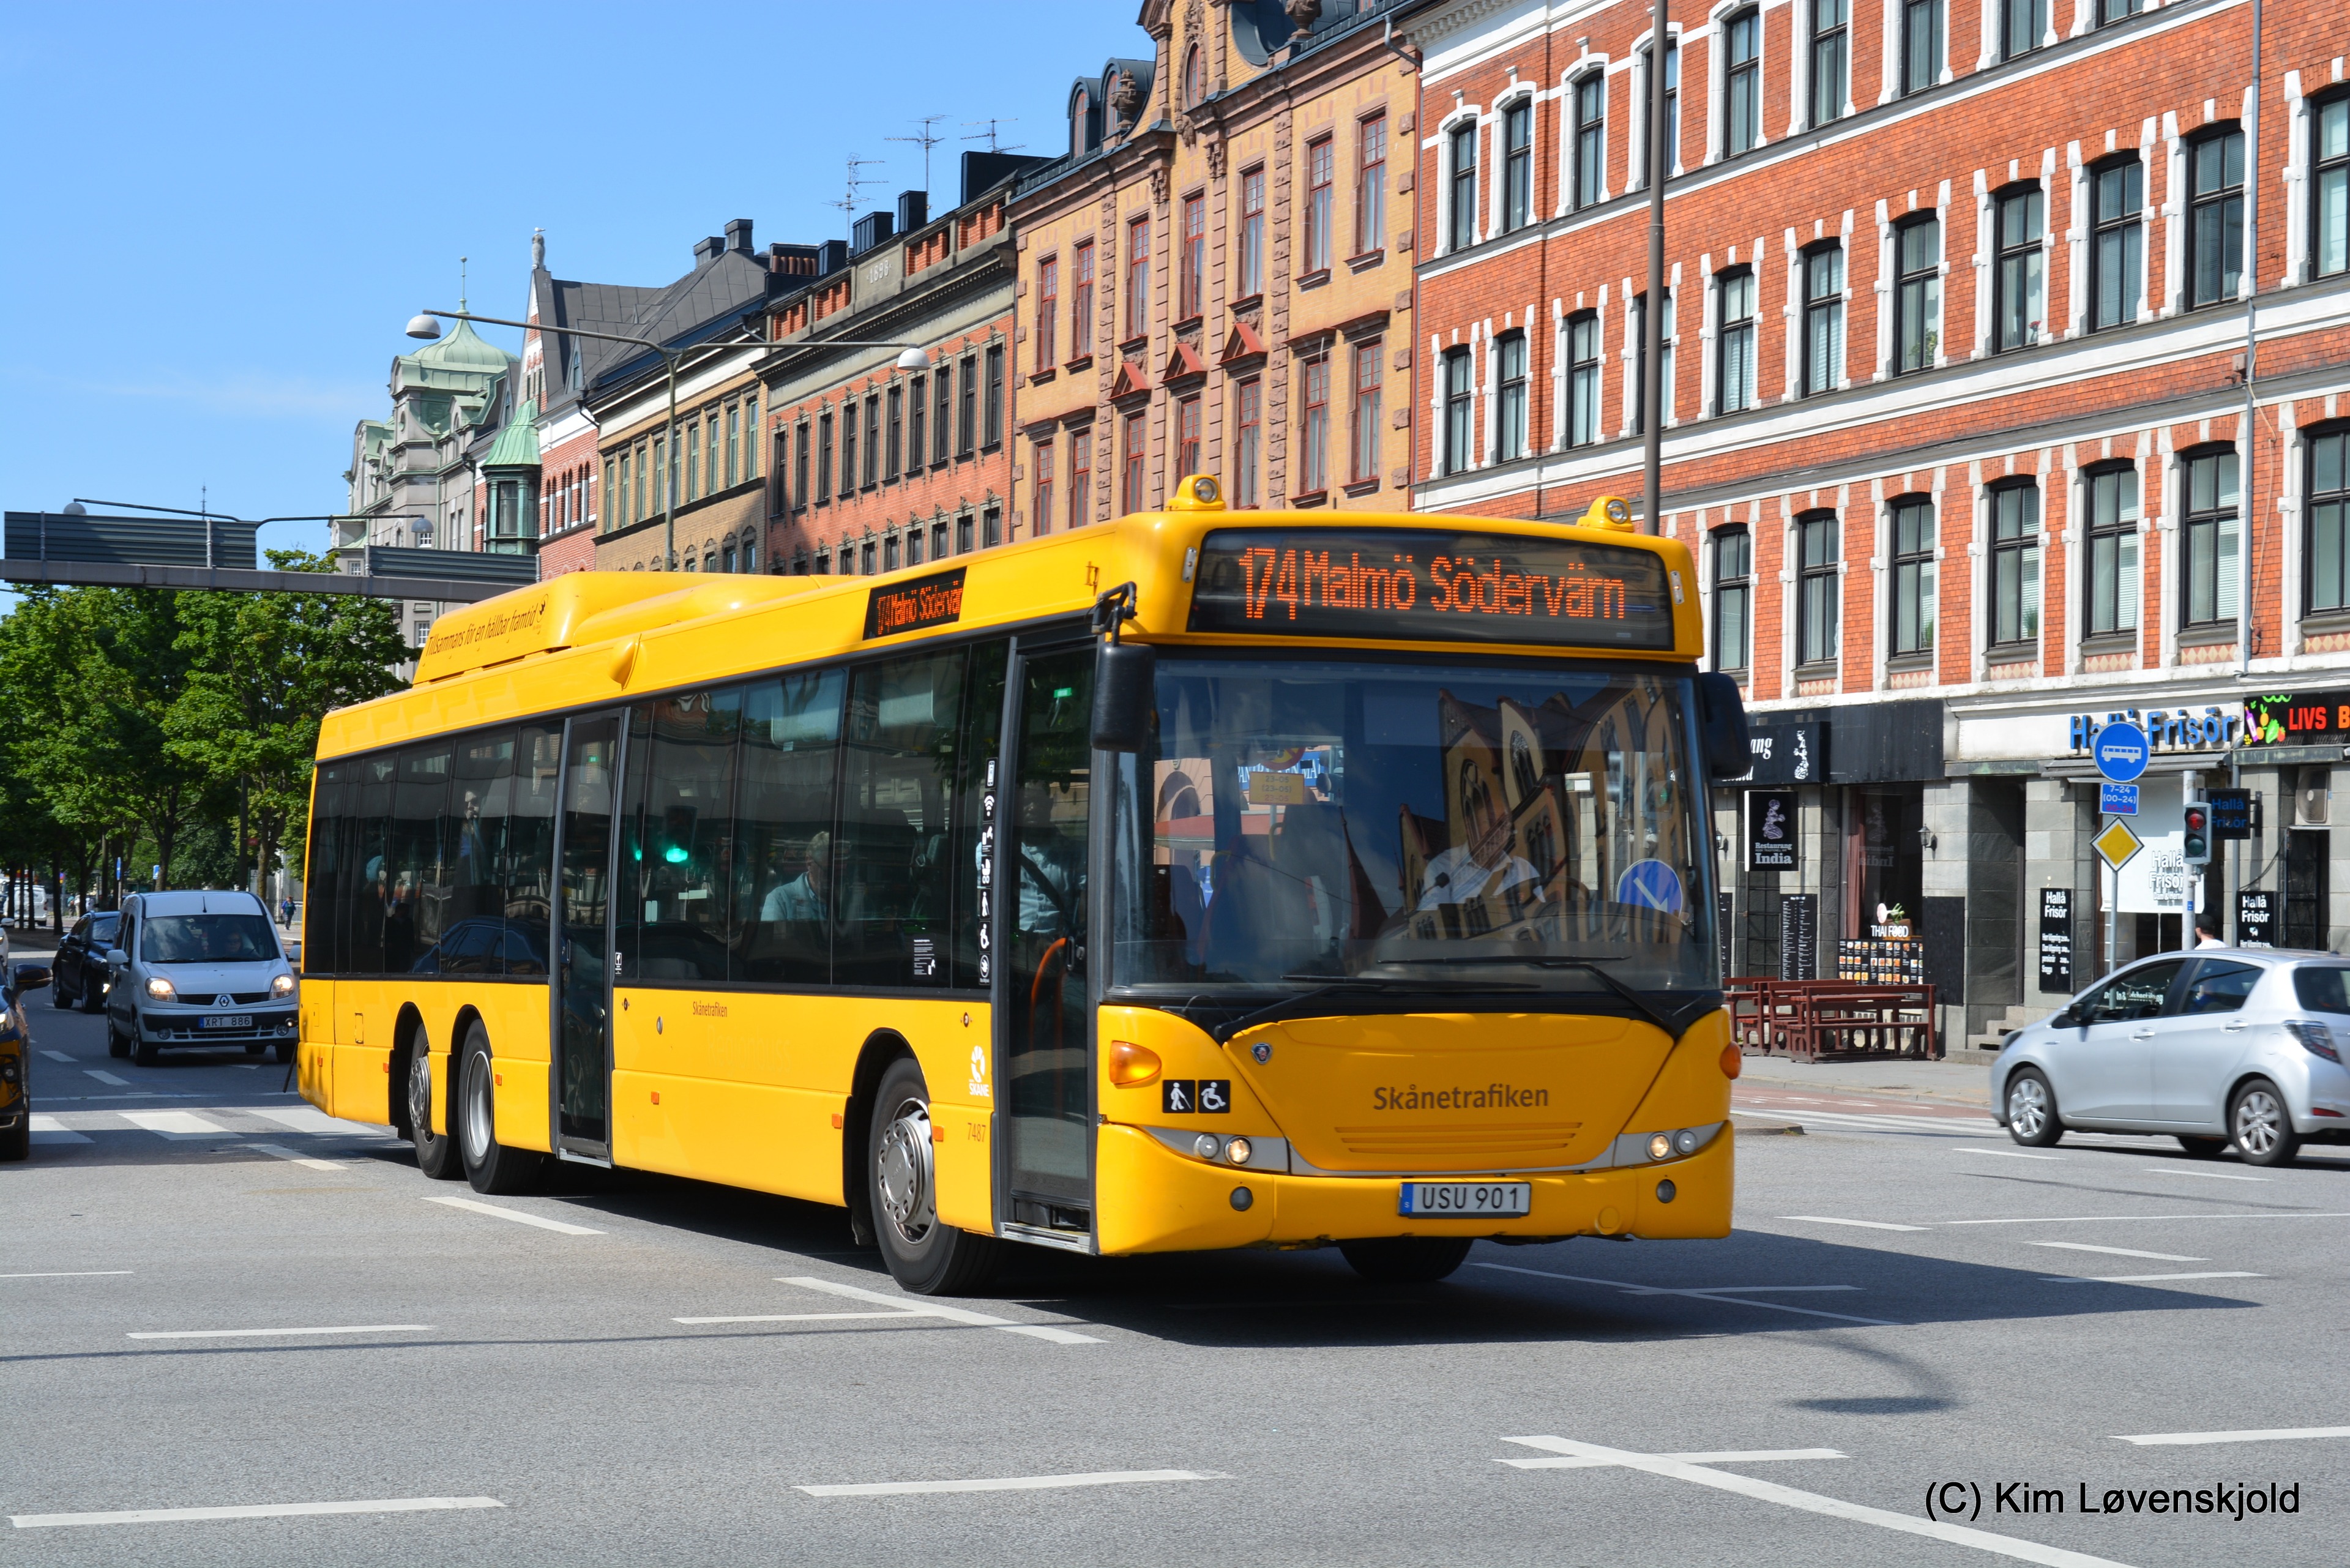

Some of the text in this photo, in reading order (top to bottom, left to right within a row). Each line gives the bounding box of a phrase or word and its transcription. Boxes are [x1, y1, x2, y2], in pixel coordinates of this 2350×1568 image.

[1239, 548, 1625, 620] 174 Malmö Södervärn
[426, 603, 539, 656] Tillsammans för en hållbar framtid
[2147, 706, 2237, 746] Frisör
[2289, 706, 2327, 731] LIVS
[2103, 794, 2136, 804] (00-24)
[2212, 797, 2245, 810] Hallå
[2106, 804, 2133, 813] 00-24
[1755, 853, 1792, 864] India
[2152, 849, 2183, 868] Hallå
[2149, 872, 2183, 889] Frisör
[2046, 891, 2066, 904] Hallå
[2242, 895, 2267, 908] Hallå
[2045, 905, 2067, 918] Frisör
[2242, 910, 2270, 922] Frisör
[1870, 925, 1909, 938] THAI FOOD
[693, 1000, 728, 1017] Skånetrafiken
[205, 1017, 250, 1026] XRT 886
[1373, 1083, 1548, 1110] Skånetrafiken
[967, 1122, 986, 1143] 7487
[1422, 1187, 1467, 1209] USU
[1475, 1187, 1517, 1209] 901
